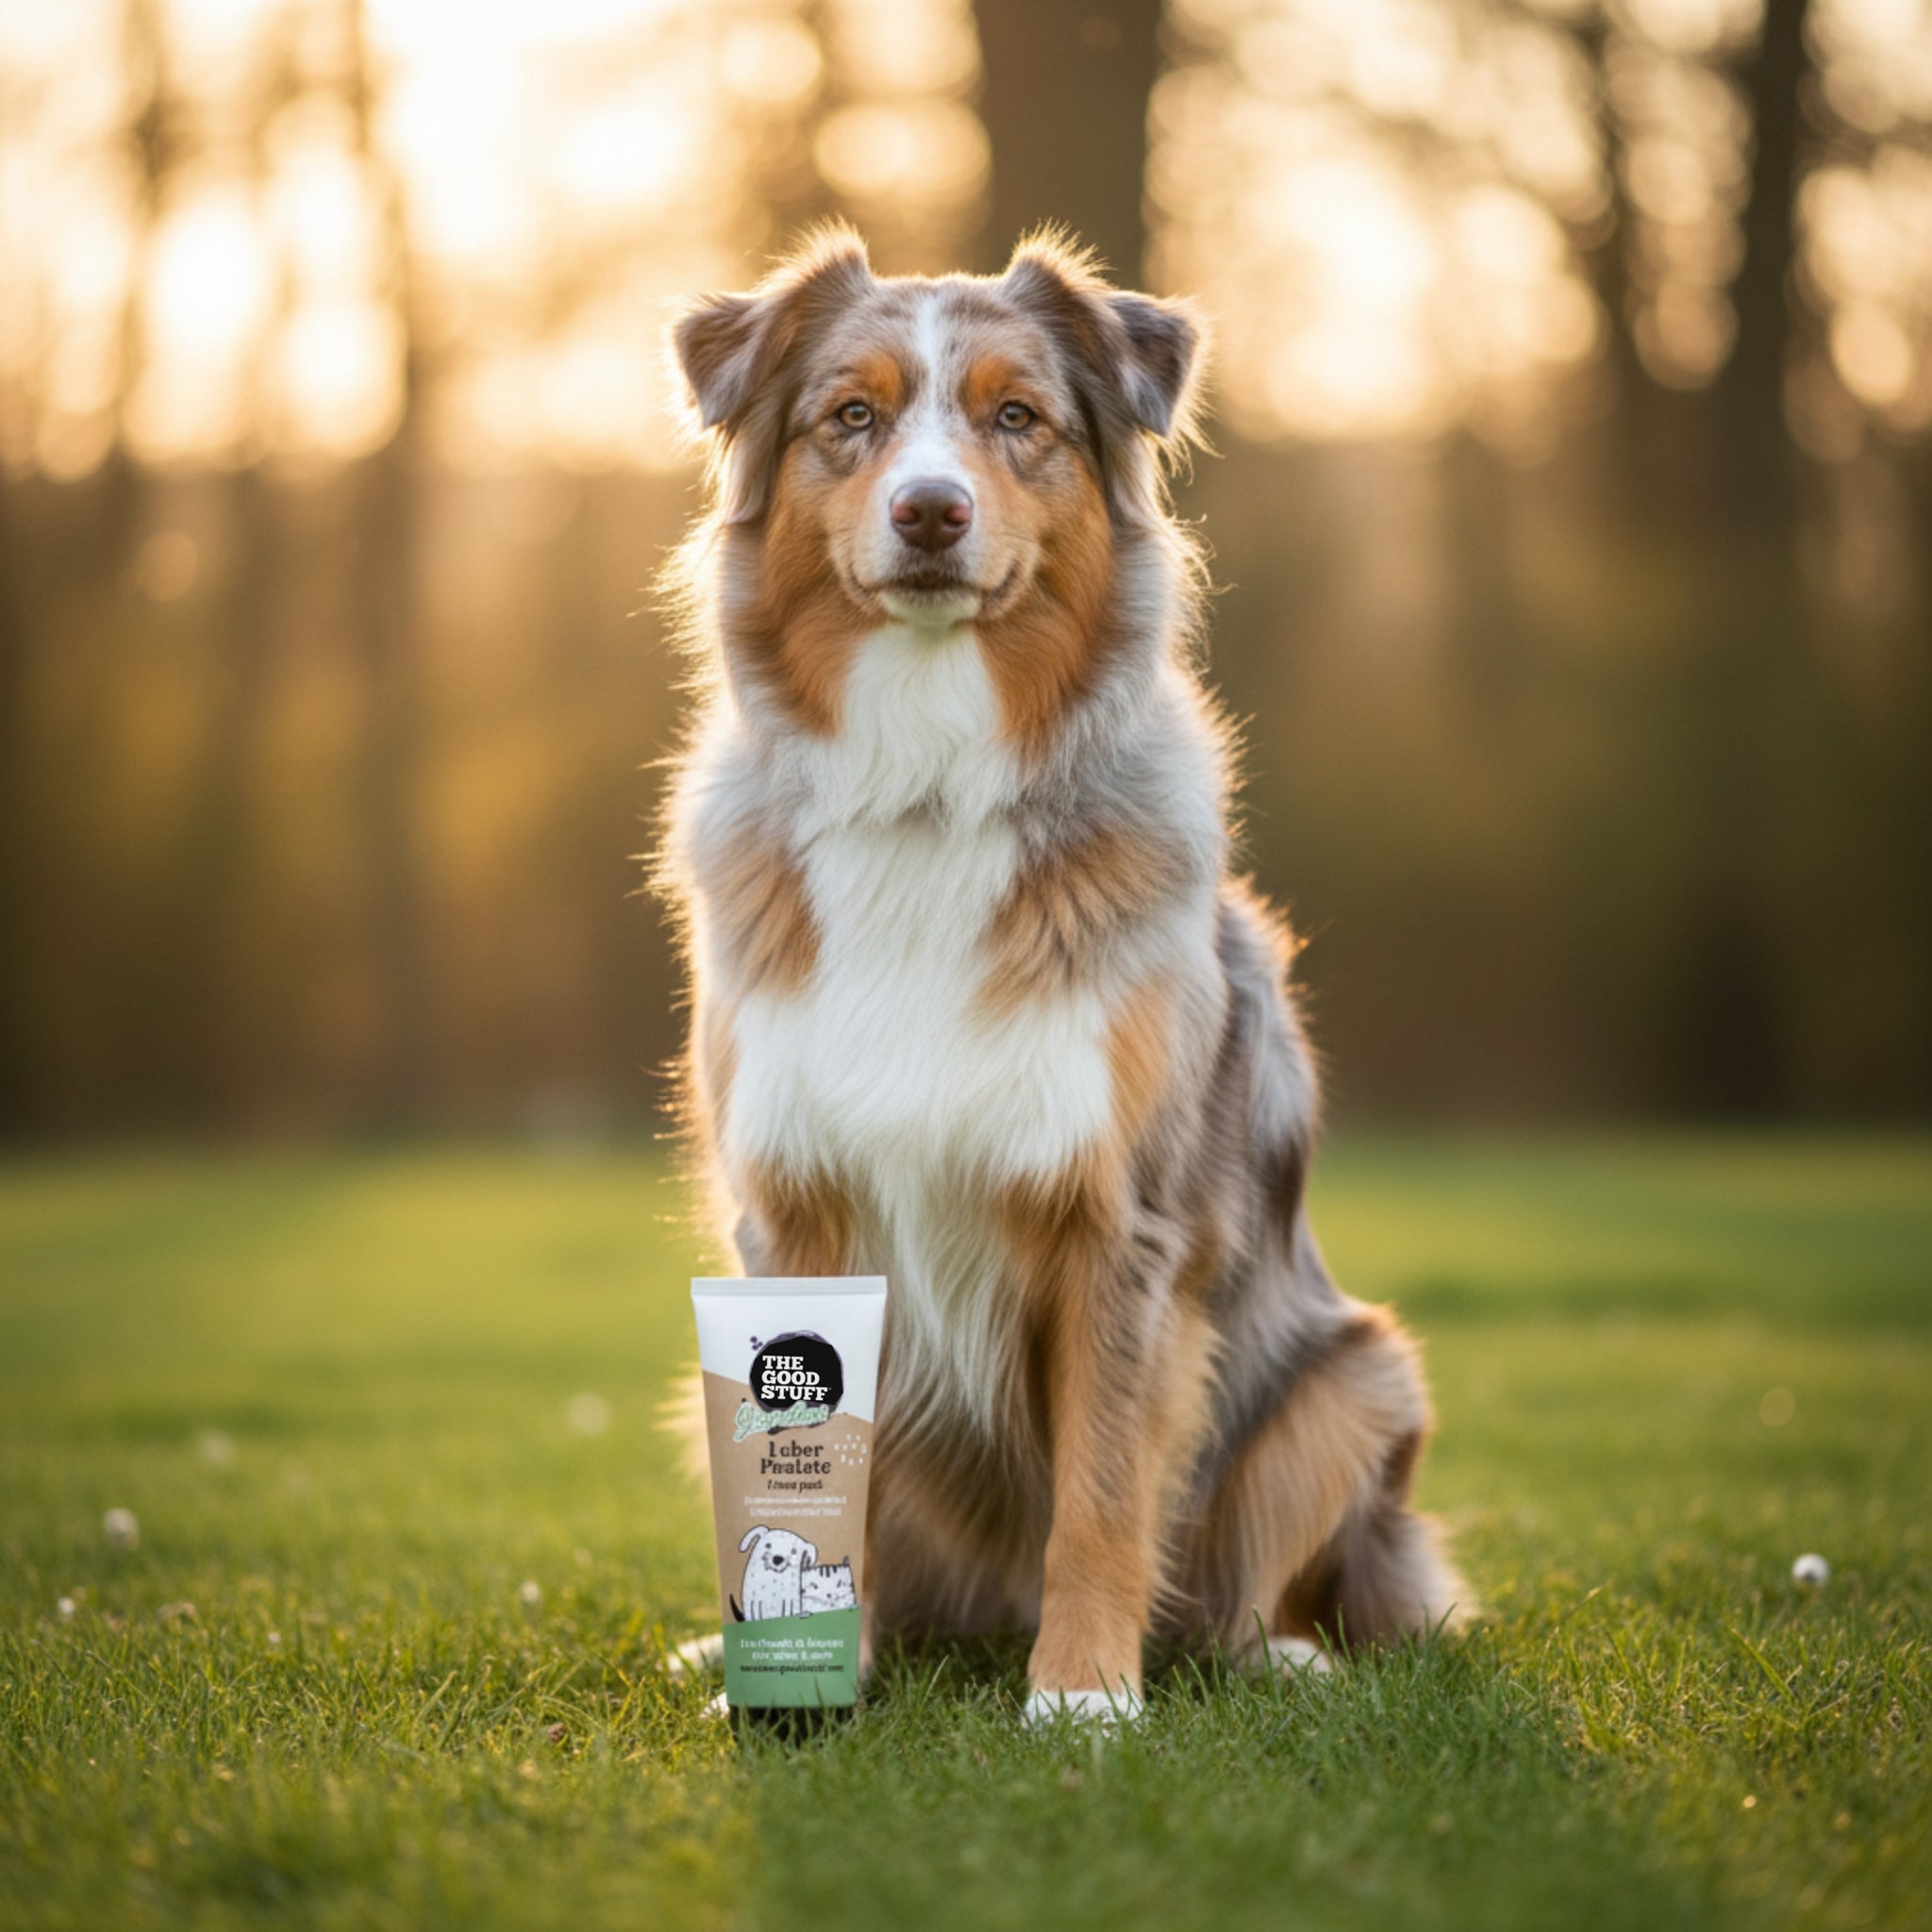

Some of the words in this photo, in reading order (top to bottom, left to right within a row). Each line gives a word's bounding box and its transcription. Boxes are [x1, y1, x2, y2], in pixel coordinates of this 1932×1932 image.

[762, 1355, 804, 1371] THE
[761, 1370, 821, 1386] GOOD
[760, 1385, 828, 1401] STUFF
